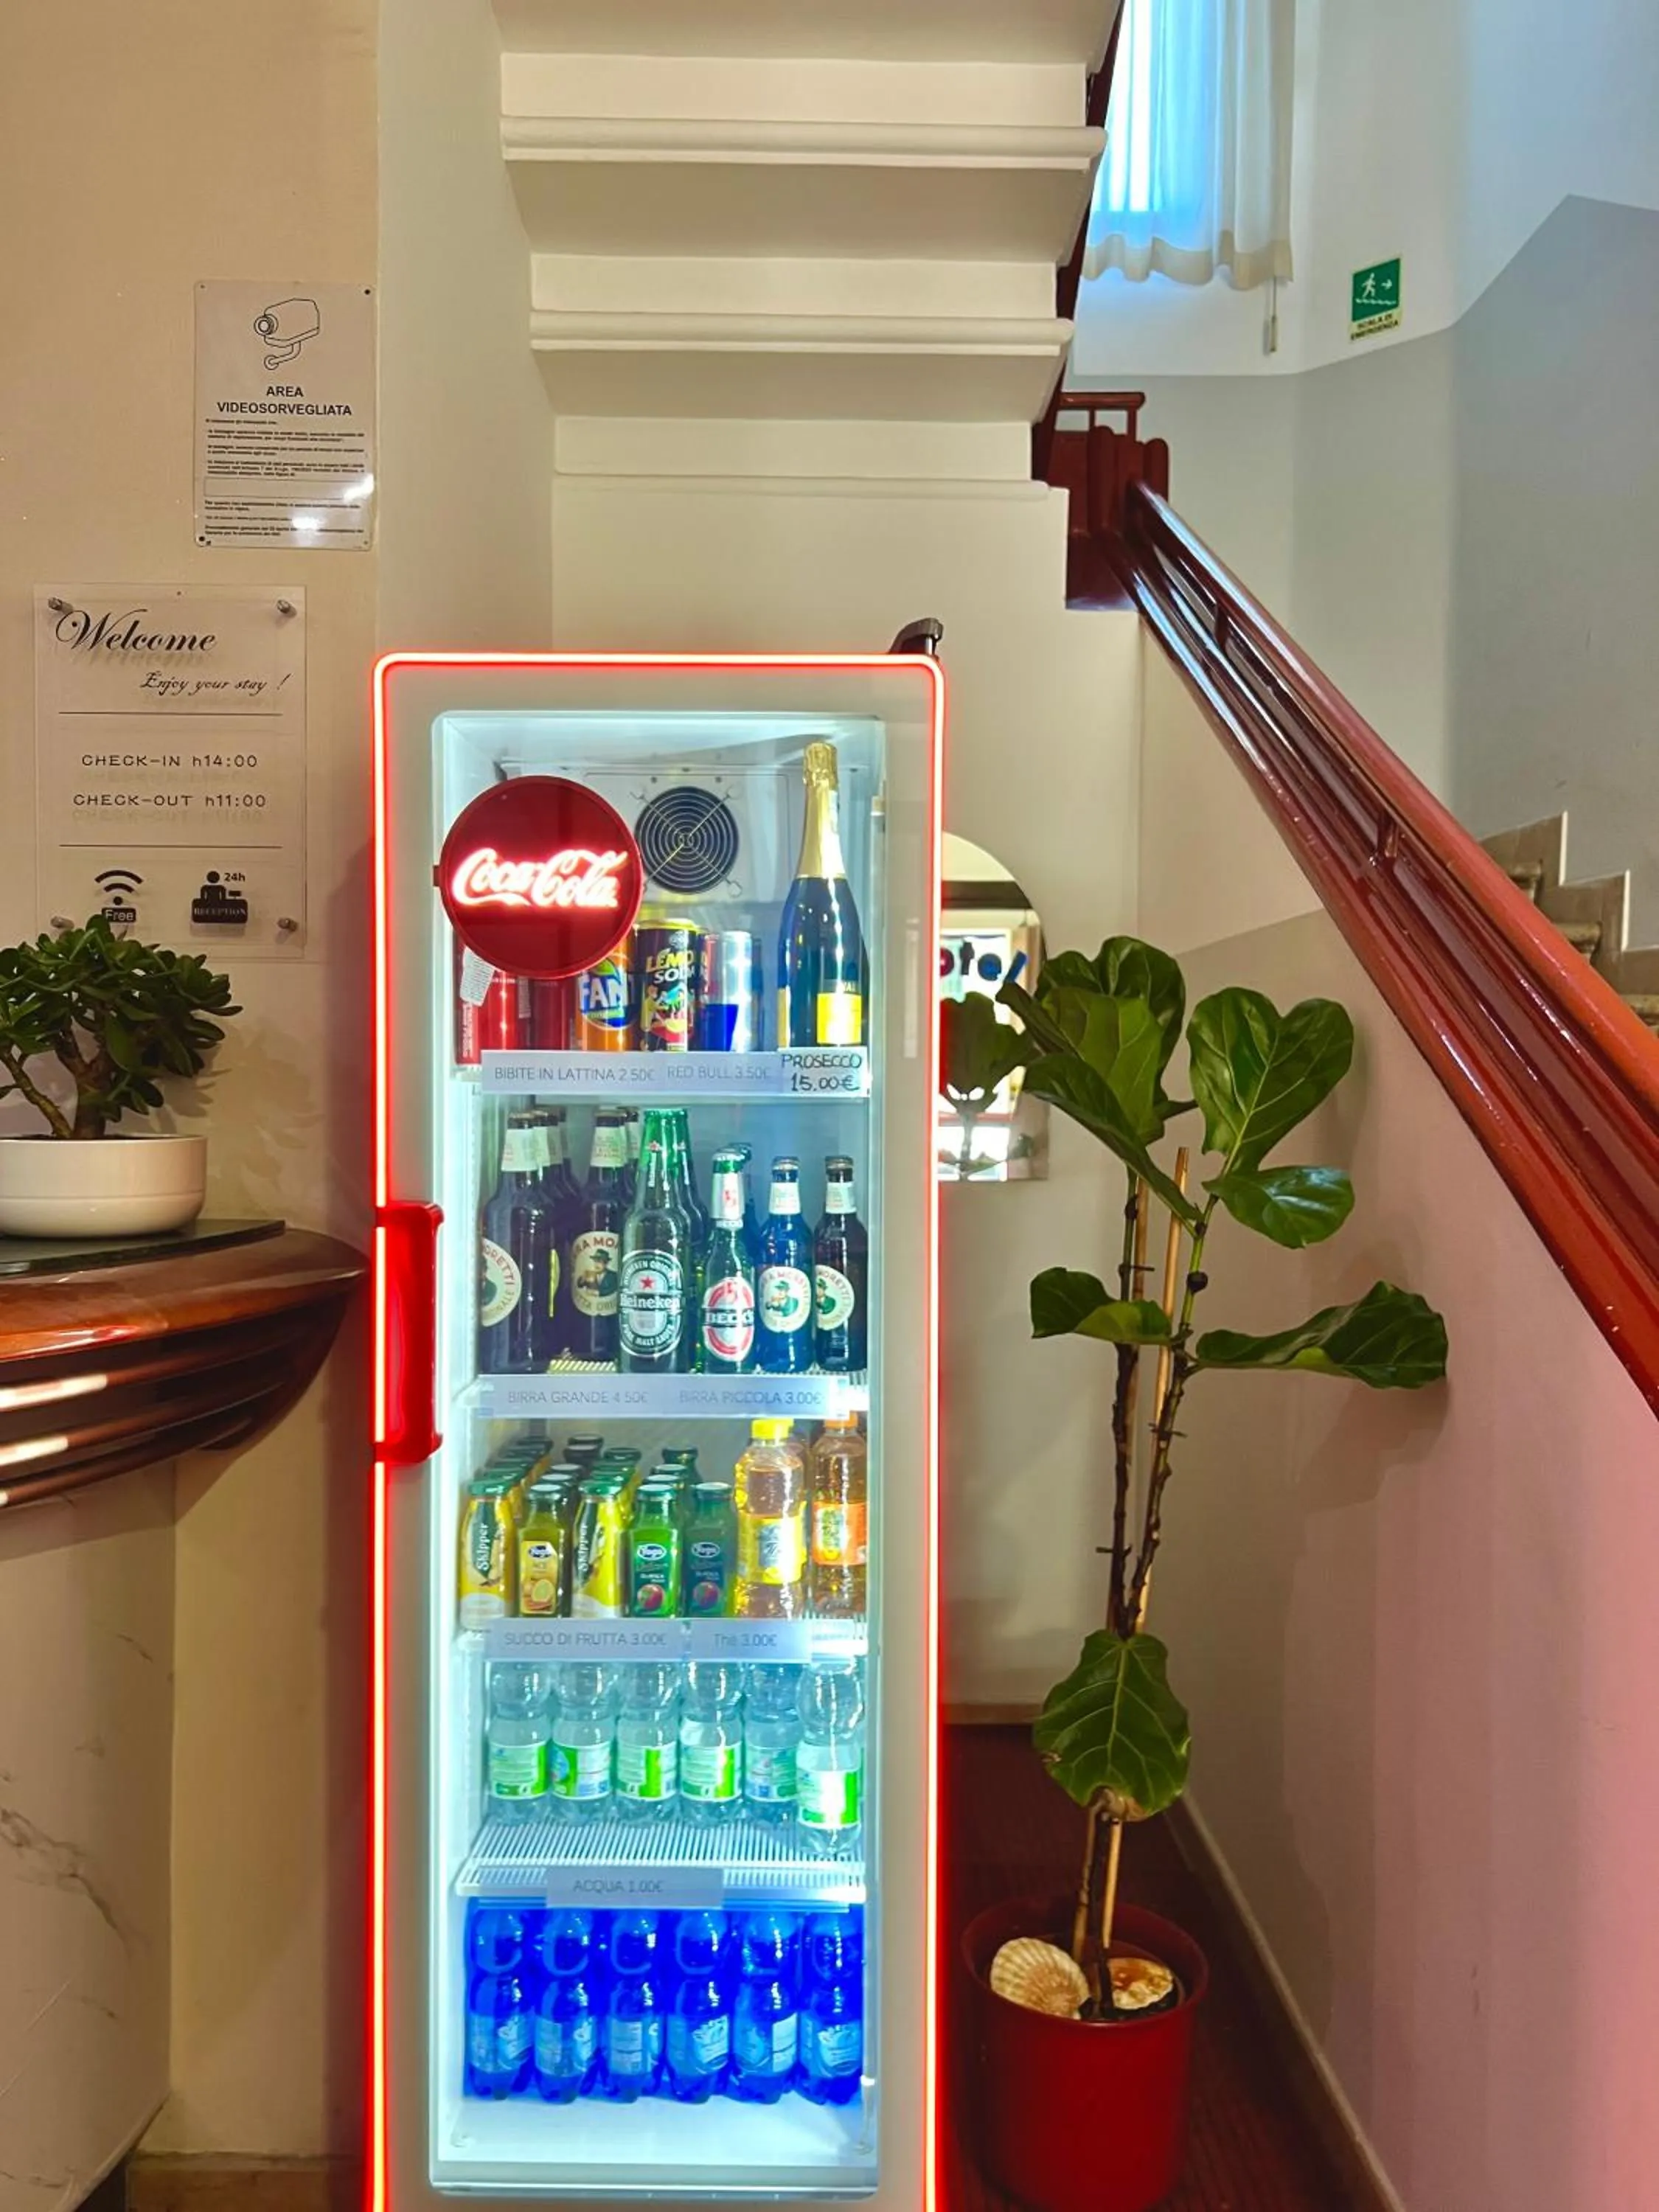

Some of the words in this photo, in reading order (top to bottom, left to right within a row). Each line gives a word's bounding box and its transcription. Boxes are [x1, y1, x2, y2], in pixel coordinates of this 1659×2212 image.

[265, 386, 304, 397] AREA
[217, 402, 352, 416] VIDEOSORVEGLIATA
[55, 608, 217, 652] Welcome
[140, 671, 189, 695] Enjoy
[189, 679, 229, 695] your
[234, 678, 268, 695] stay
[81, 754, 181, 768] CHECK-IN
[192, 754, 258, 768] h14:00
[73, 793, 193, 807] CHECK-OUT
[205, 794, 266, 808] h11:00
[223, 872, 246, 883] 24h
[105, 908, 133, 921] Free
[782, 1053, 862, 1069] PROSECCO
[495, 1067, 535, 1079] BIBITE
[539, 1068, 553, 1080] IN
[558, 1068, 616, 1081] LATTINA
[667, 1065, 694, 1077] RED
[698, 1066, 731, 1079] BULL
[790, 1071, 860, 1092] 15.00€
[508, 1391, 547, 1404] BIRRA
[550, 1391, 608, 1405] GRANDE
[679, 1390, 719, 1404] BIRRA
[723, 1390, 782, 1405] PICCOLA
[476, 1523, 490, 1571] Skipper
[578, 1523, 588, 1573] Skipper
[504, 1632, 553, 1646] SUCCO
[557, 1632, 574, 1646] DI
[576, 1632, 627, 1646] FRUTTA
[573, 1879, 625, 1893] ACQUA
